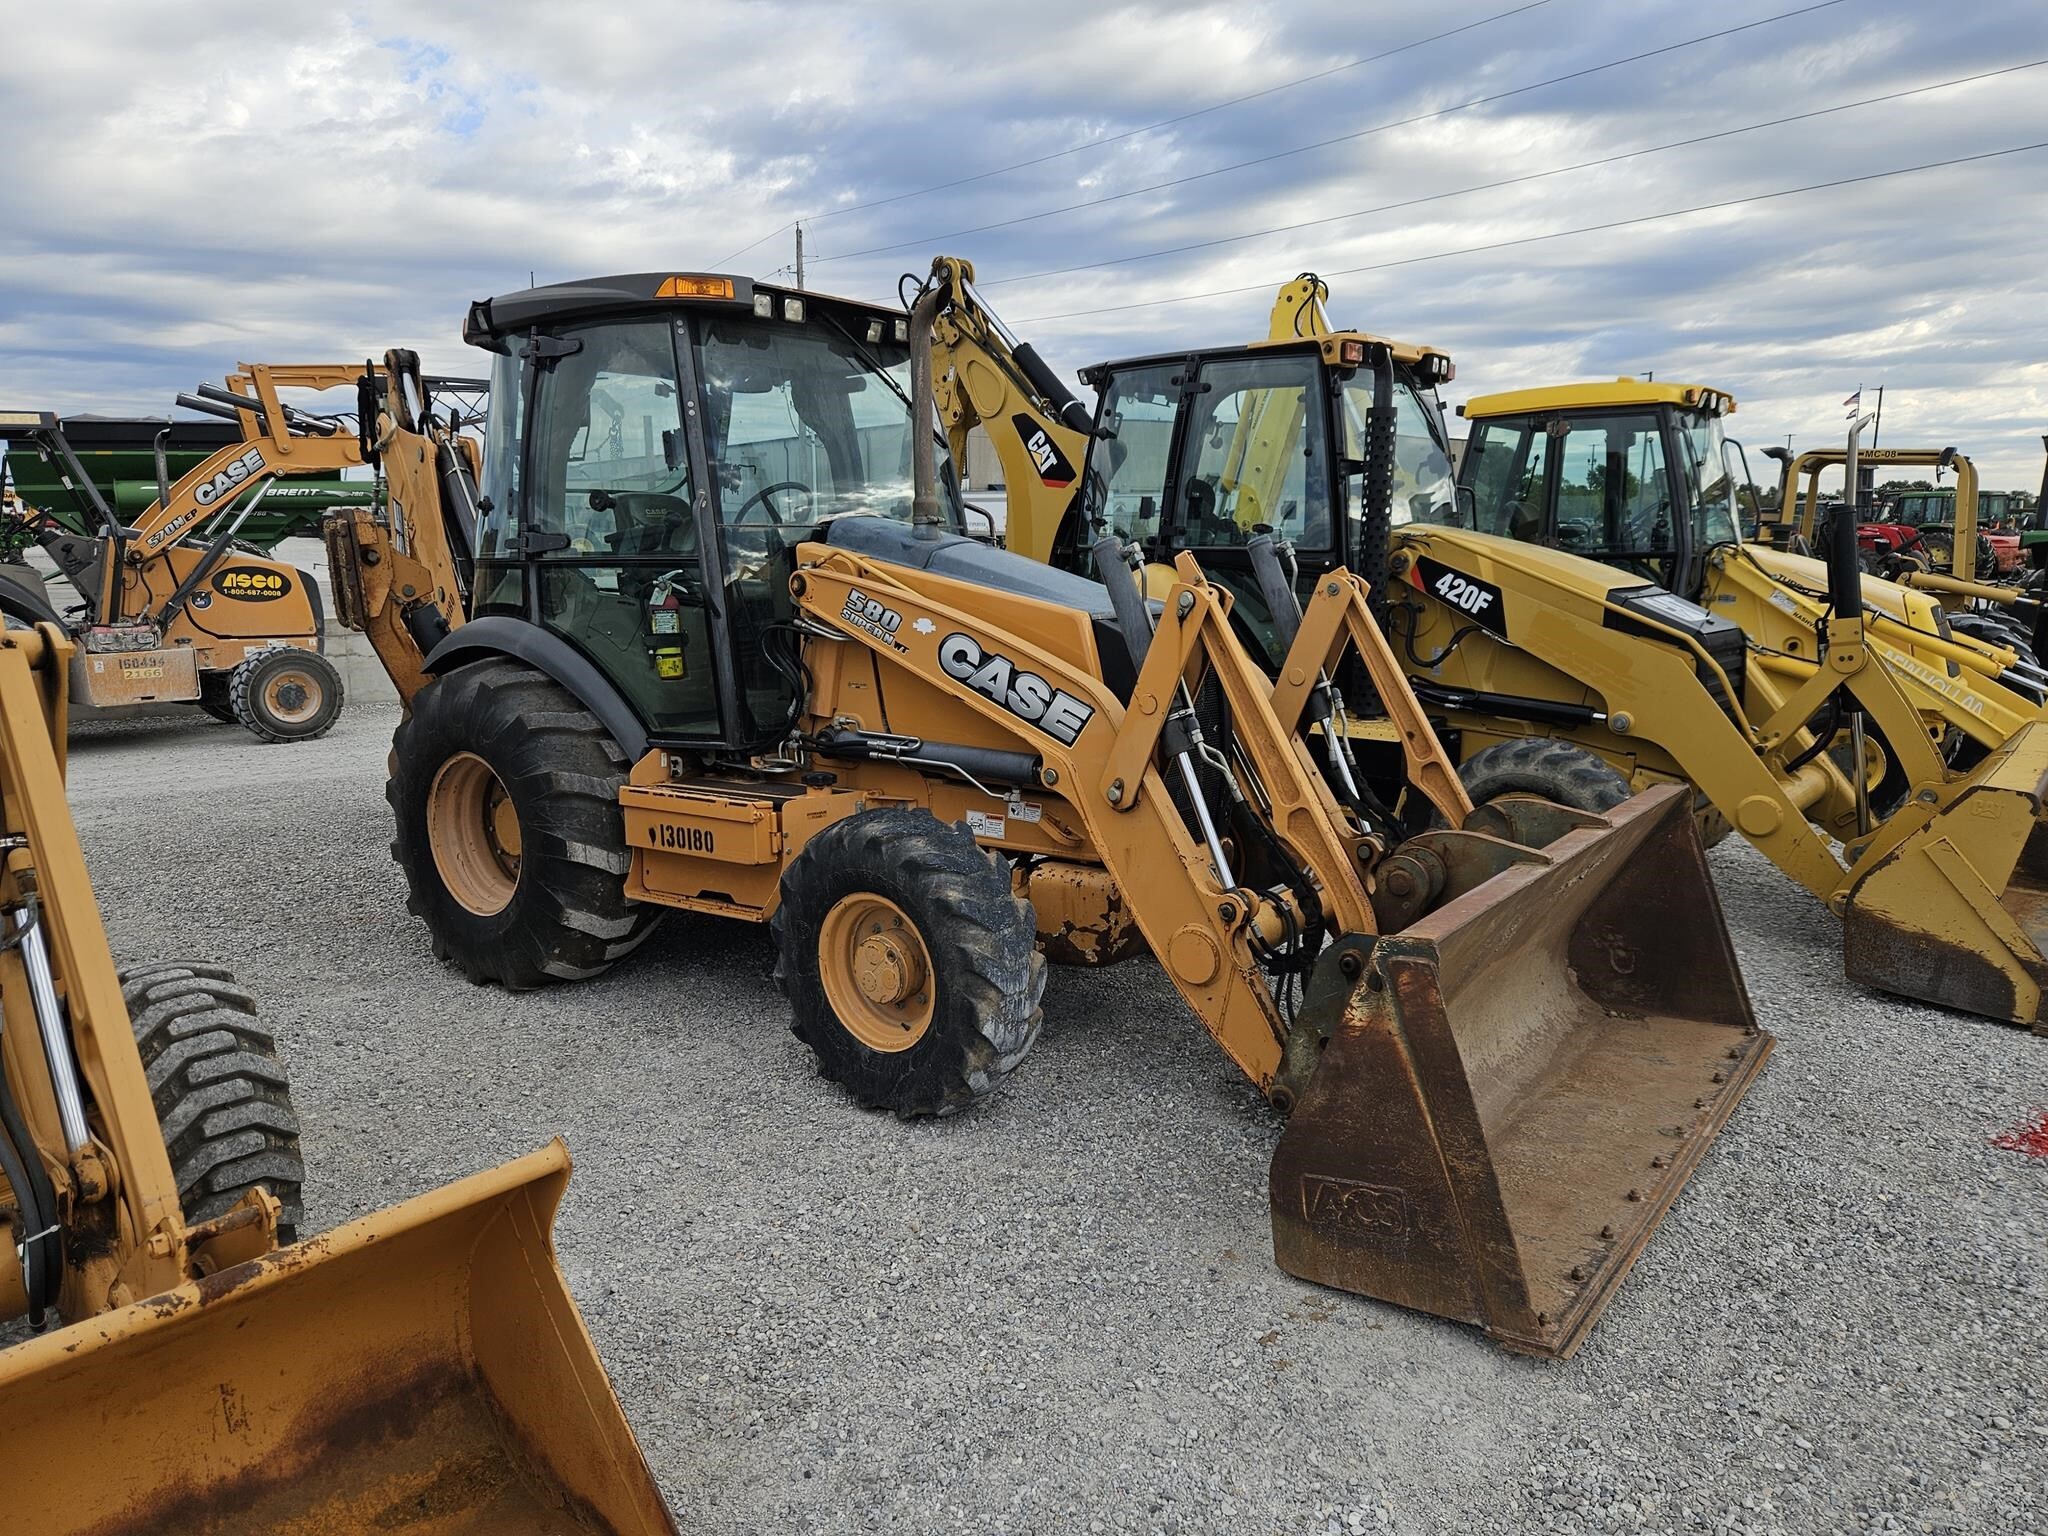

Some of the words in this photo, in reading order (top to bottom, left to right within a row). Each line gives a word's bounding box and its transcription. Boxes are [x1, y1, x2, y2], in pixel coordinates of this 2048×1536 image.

[1027, 430, 1058, 474] CAT
[194, 447, 266, 506] CASE
[265, 488, 321, 497] BRENT
[146, 515, 186, 549] 570N
[184, 508, 198, 523] EP
[222, 572, 282, 589] ASCO
[1435, 572, 1494, 614] 420F
[840, 608, 884, 640] SUPER
[881, 631, 896, 646] N
[893, 641, 910, 654] WT
[845, 587, 903, 633] 580
[125, 669, 162, 679] 2166
[938, 631, 1097, 748] CASE
[659, 823, 715, 854] 130180
